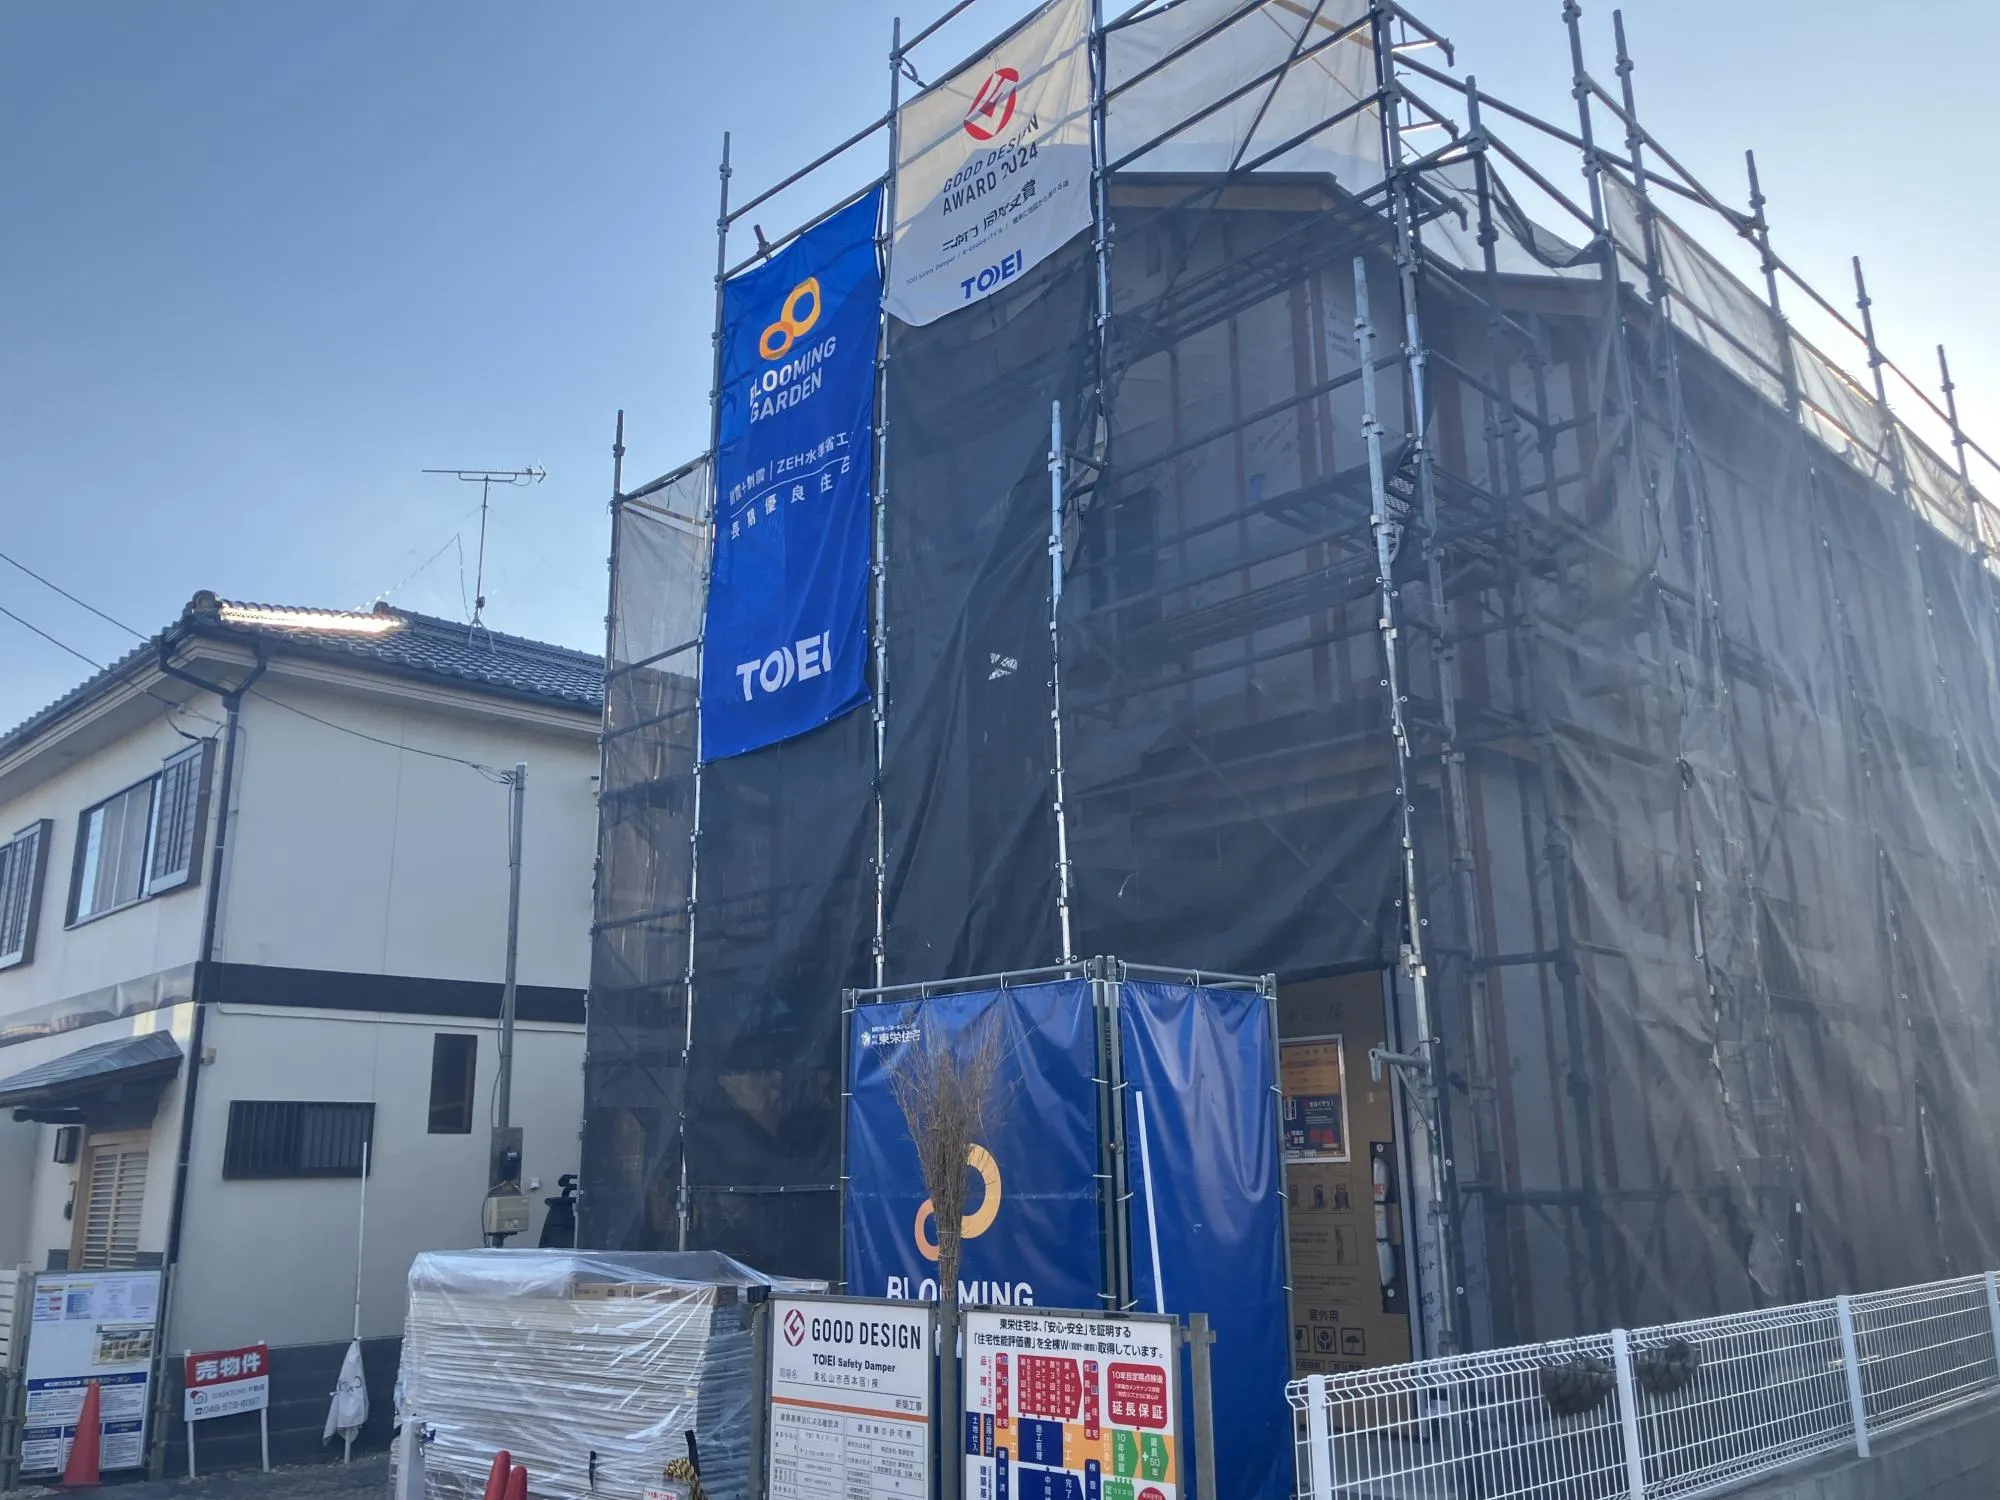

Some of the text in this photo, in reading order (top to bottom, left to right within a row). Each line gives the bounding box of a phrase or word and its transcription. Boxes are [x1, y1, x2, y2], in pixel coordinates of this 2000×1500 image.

[944, 113, 1039, 194] GOOD DESIN
[943, 171, 997, 216] AWARD
[960, 249, 1023, 300] TOEI
[750, 366, 822, 424] GARDEN
[736, 630, 832, 702] TOEI
[886, 1276, 1034, 1307] BLOMING
[812, 1318, 921, 1350] GOOD DESIGN
[195, 1352, 261, 1382] 売物件
[812, 1353, 896, 1374] TOEI Safety Damper
[1112, 1400, 1164, 1420] 延長保証
